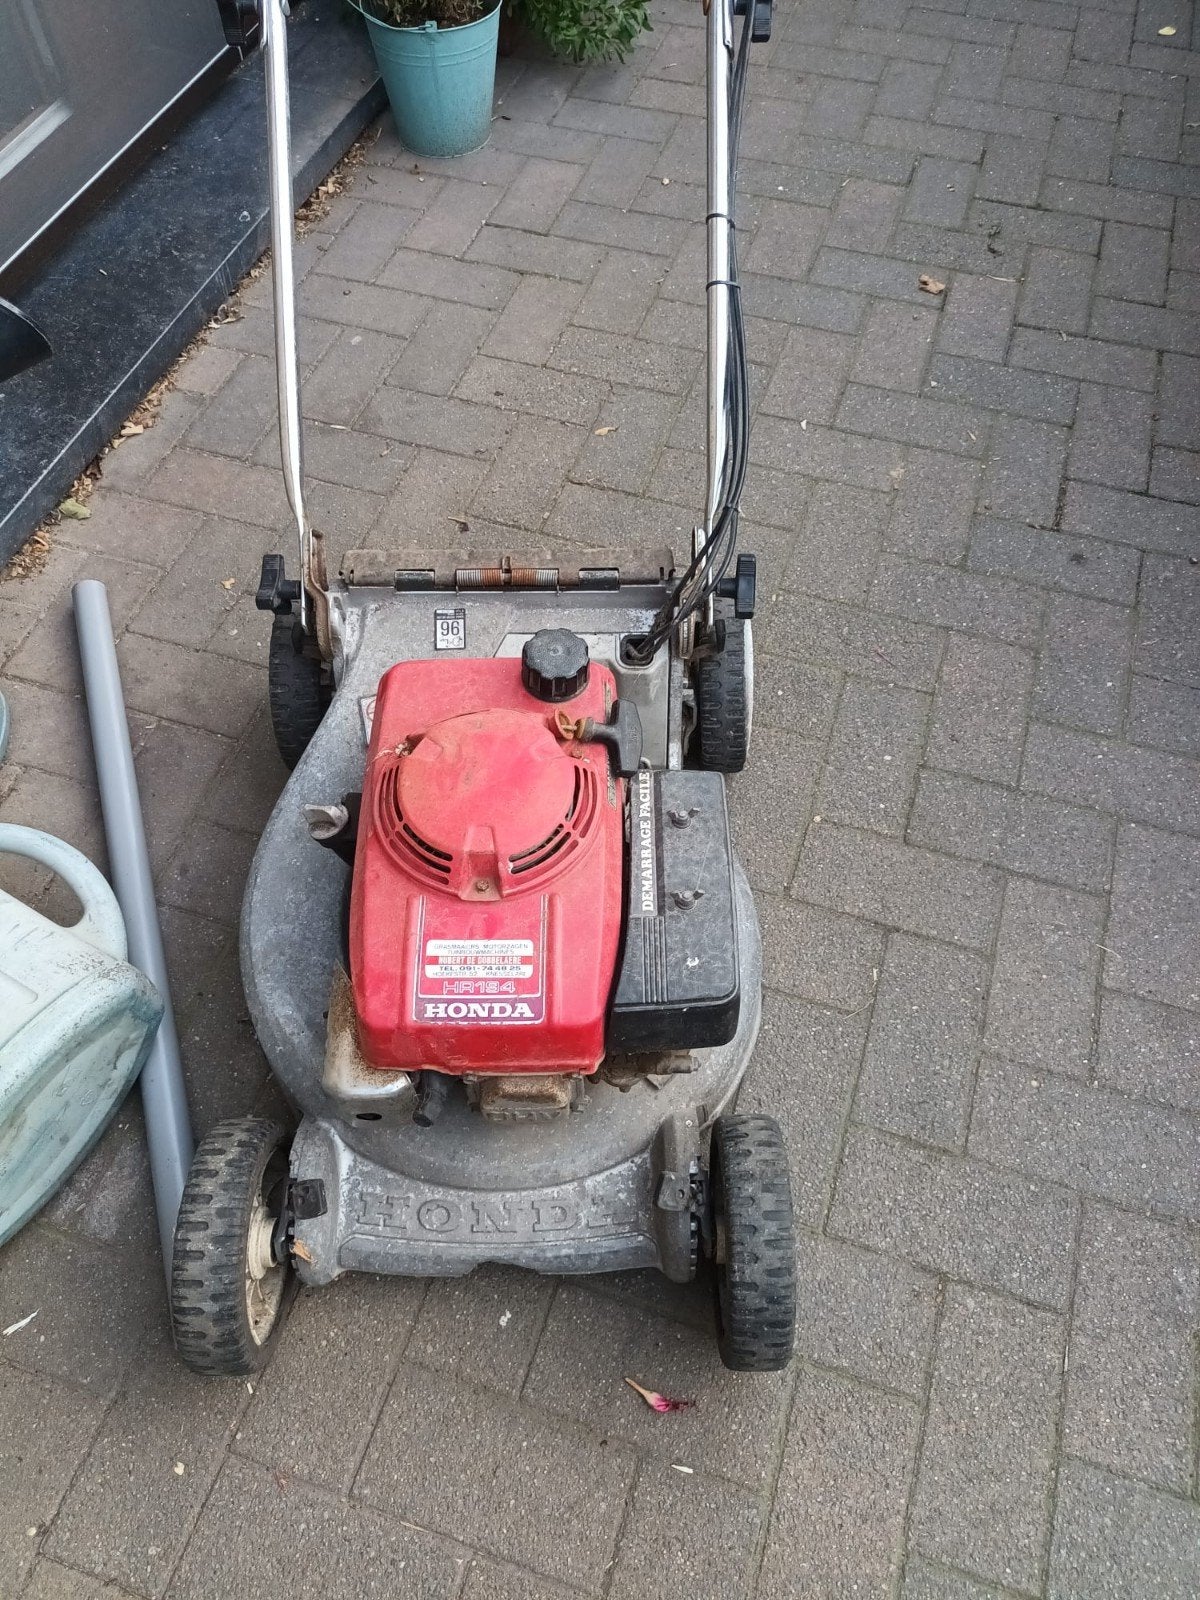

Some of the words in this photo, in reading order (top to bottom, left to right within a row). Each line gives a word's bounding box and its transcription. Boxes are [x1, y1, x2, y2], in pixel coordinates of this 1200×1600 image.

[440, 620, 460, 636] 96
[638, 772, 651, 818] FACILE
[640, 820, 654, 912] DEMARRAGE
[467, 956, 476, 965] DE
[423, 1002, 535, 1018] HONDA
